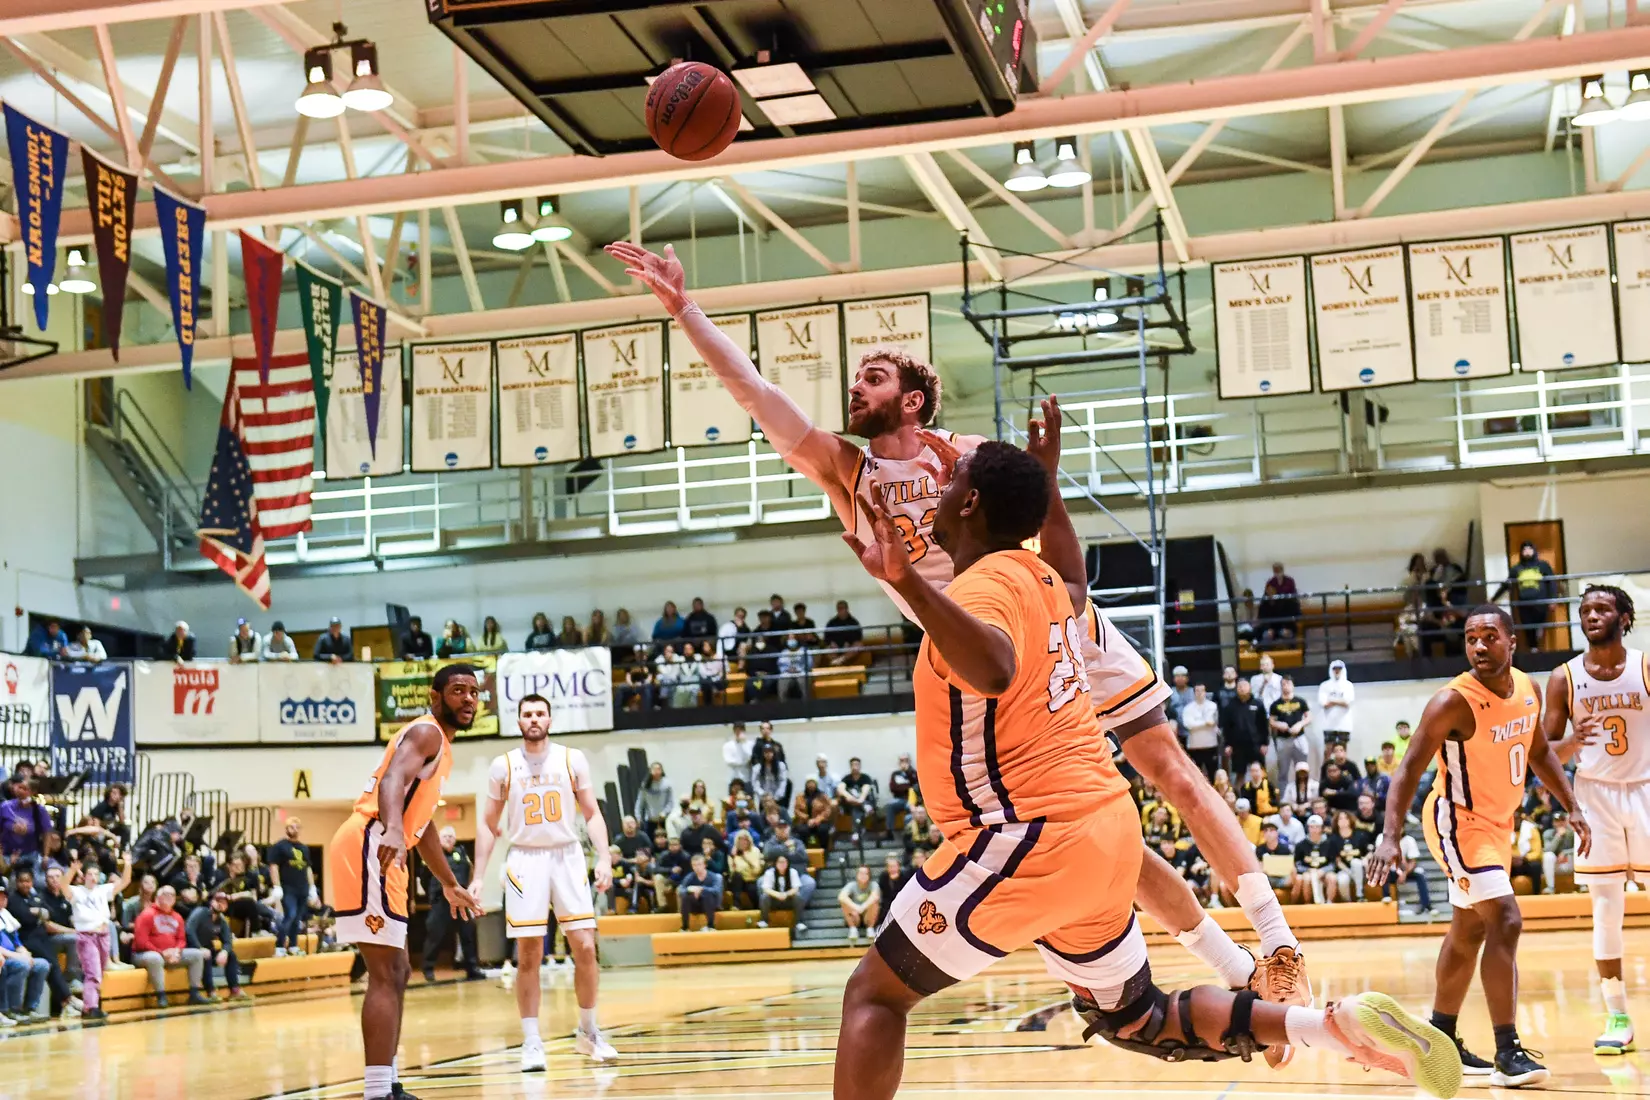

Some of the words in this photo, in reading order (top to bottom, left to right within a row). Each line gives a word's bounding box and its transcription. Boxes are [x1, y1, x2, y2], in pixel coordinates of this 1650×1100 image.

[660, 71, 704, 126] Wilson
[26, 125, 43, 268] JOHNSTOWN
[97, 163, 113, 228] HILL
[111, 173, 127, 263] SETON
[175, 207, 194, 345] SHEPHERD
[1519, 274, 1563, 284] WOMEN'S
[1566, 268, 1606, 279] SOCCER
[1229, 298, 1261, 307] MEN'S
[1264, 294, 1293, 304] GOLF
[1321, 301, 1357, 311] WOMEN'S
[1417, 291, 1450, 300] MEN'S
[1454, 287, 1499, 297] SOCCER
[360, 300, 374, 394] CHESTER
[369, 306, 380, 363] WEST
[851, 336, 878, 345] FIELD
[881, 331, 924, 343] HOCKEY
[775, 352, 823, 364] FOOTBALL
[502, 382, 532, 391] WOMEN'S
[534, 379, 577, 388] BASKETBALL
[589, 381, 618, 391] CROSS
[621, 376, 660, 388] COUNTRY
[612, 369, 638, 379] MEN'S
[339, 383, 387, 395] BASEL
[416, 387, 439, 395] MEN'S
[441, 384, 488, 394] BASKETBALL
[504, 668, 606, 701] UPMC
[1580, 692, 1643, 714] VILLE
[1490, 713, 1537, 743] WCU
[1603, 715, 1628, 756] 3
[55, 746, 127, 764] WEAVER
[1508, 742, 1526, 786] 0
[295, 771, 311, 799] A
[522, 790, 563, 826] 20
